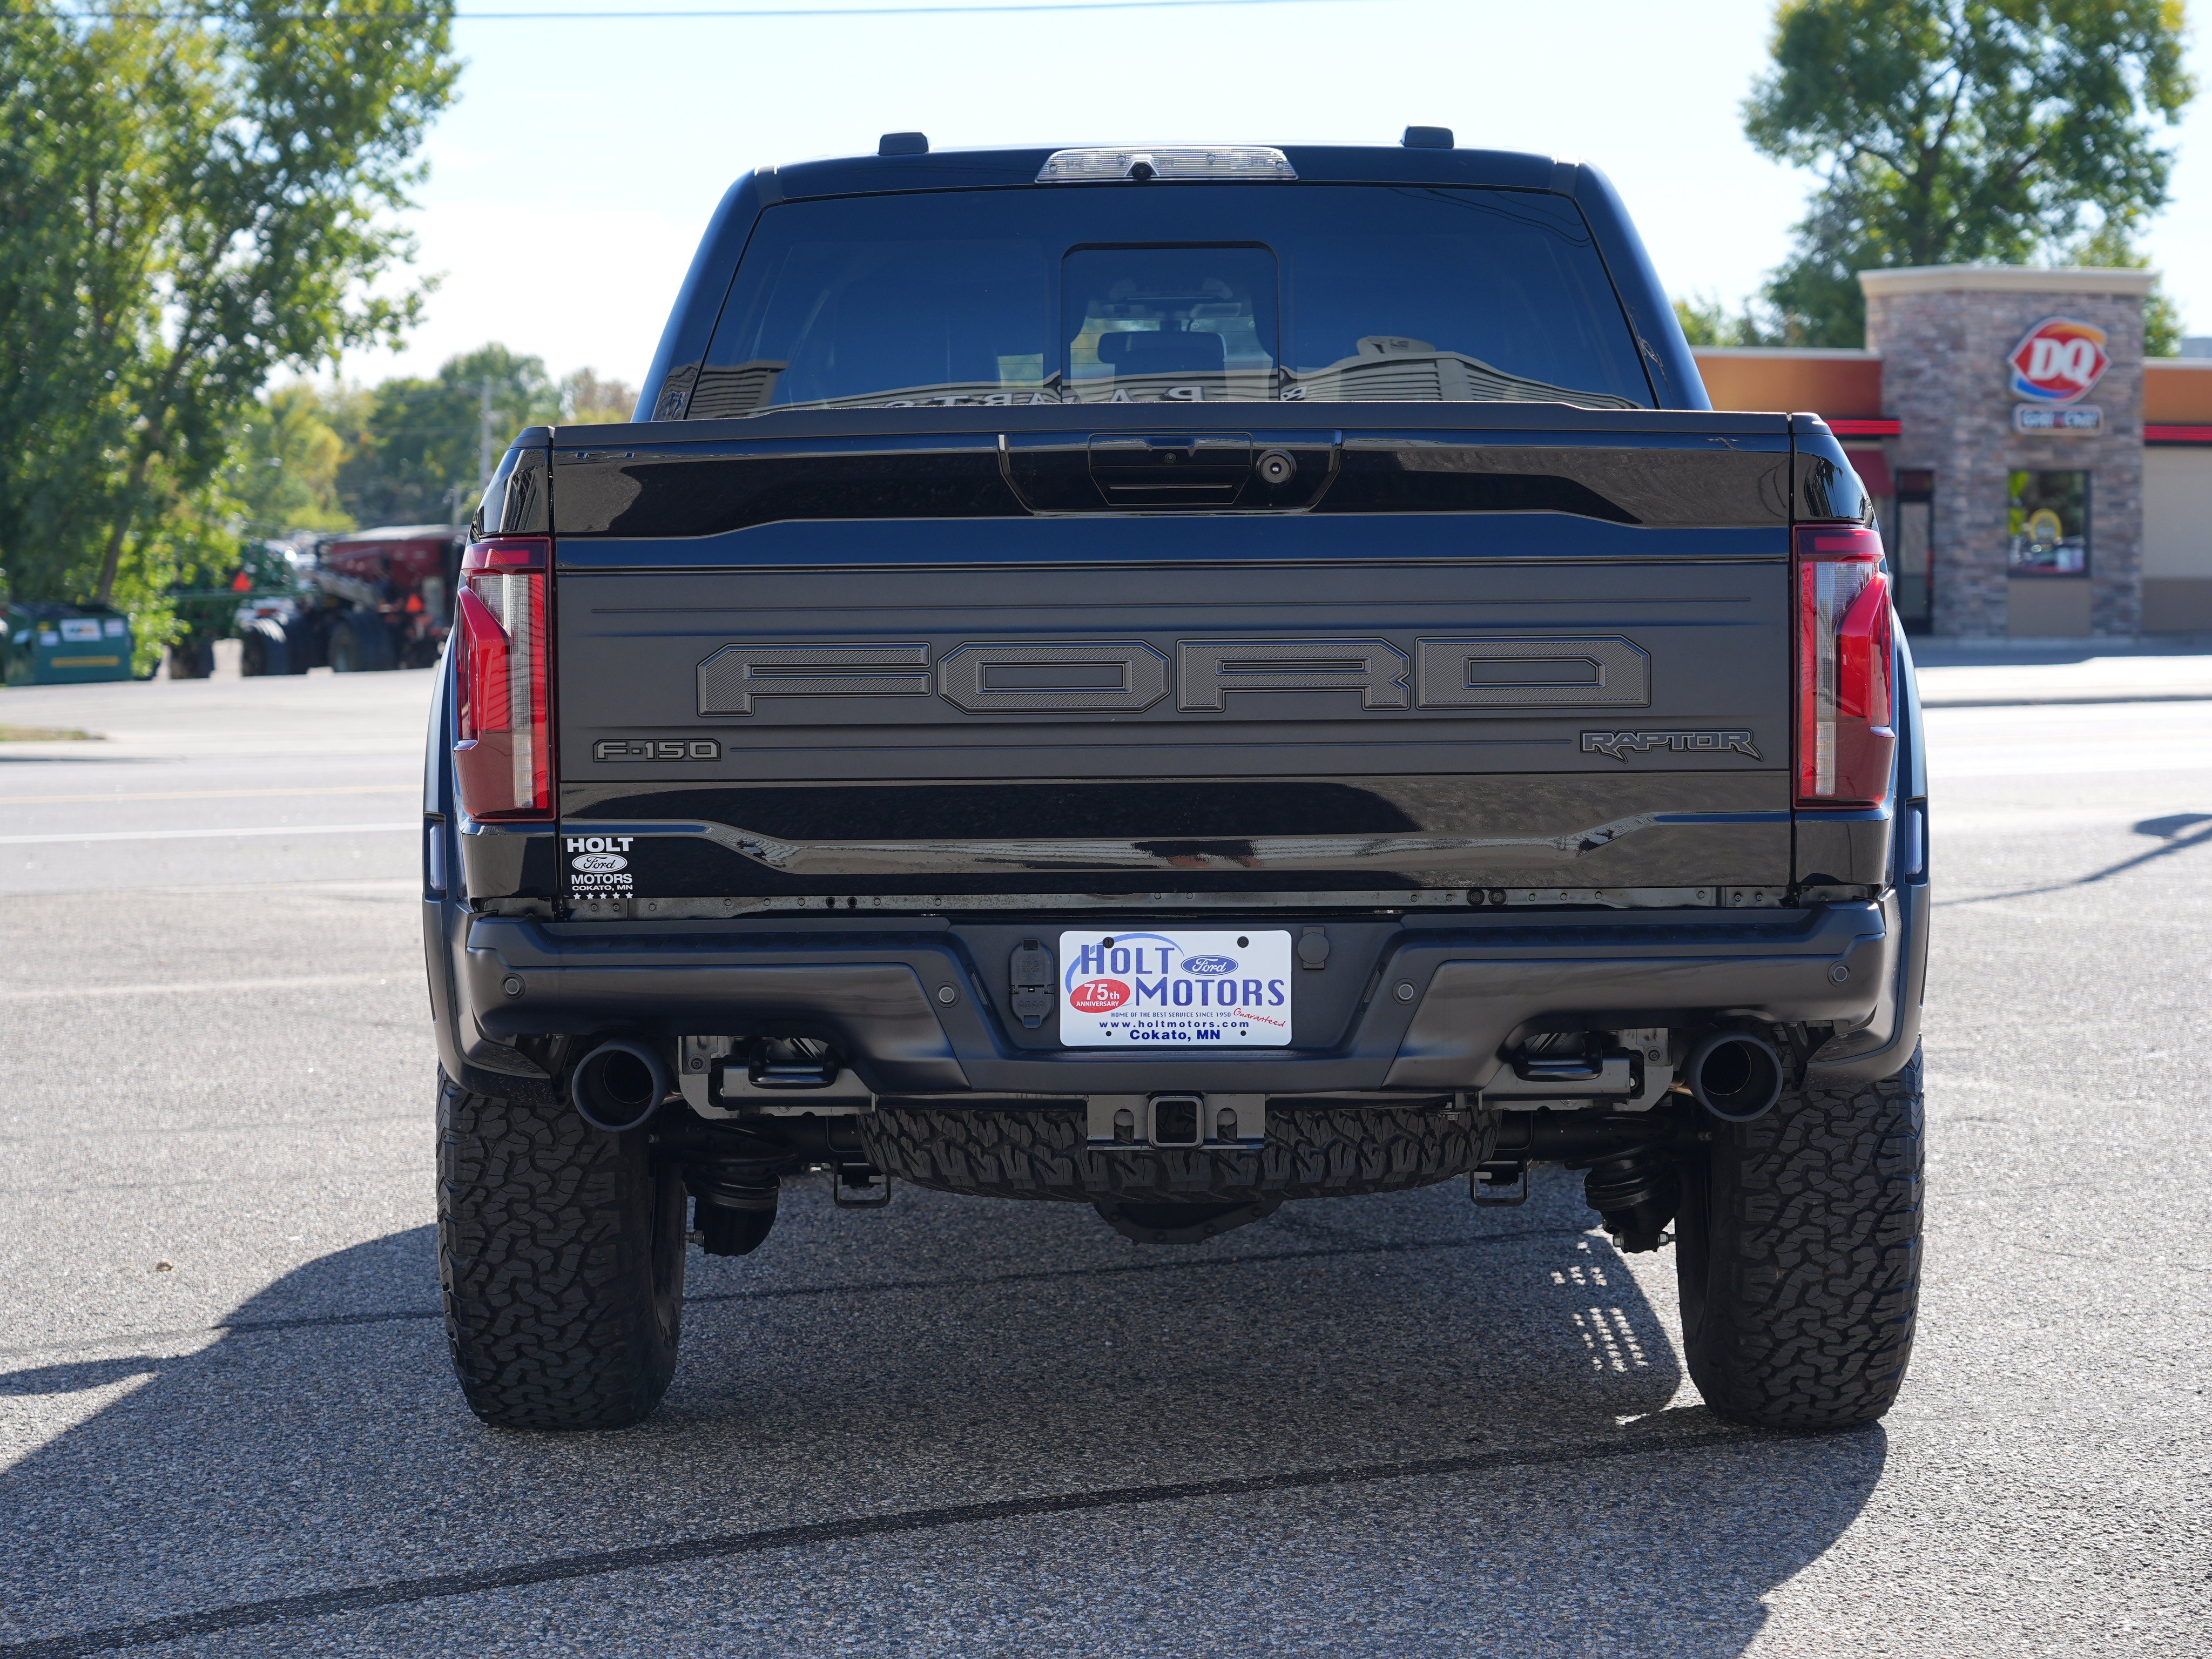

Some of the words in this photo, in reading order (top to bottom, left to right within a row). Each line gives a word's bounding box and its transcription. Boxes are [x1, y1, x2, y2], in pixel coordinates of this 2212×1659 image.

[2028, 338, 2095, 386] DQ
[697, 636, 1651, 717] FORD
[596, 740, 719, 759] F-150
[1581, 729, 1763, 763] RAPTOR
[567, 837, 633, 853] HOLT
[583, 856, 616, 869] Ford
[571, 873, 632, 884] MOTORS
[1081, 945, 1175, 974] HOLT
[1192, 957, 1228, 972] Ford
[1084, 983, 1120, 1000] 75th
[1136, 977, 1284, 1006] MOTORS
[1233, 1008, 1286, 1027] Guaranteed
[1130, 1029, 1191, 1042] Cokato,
[1197, 1029, 1220, 1040] MN
